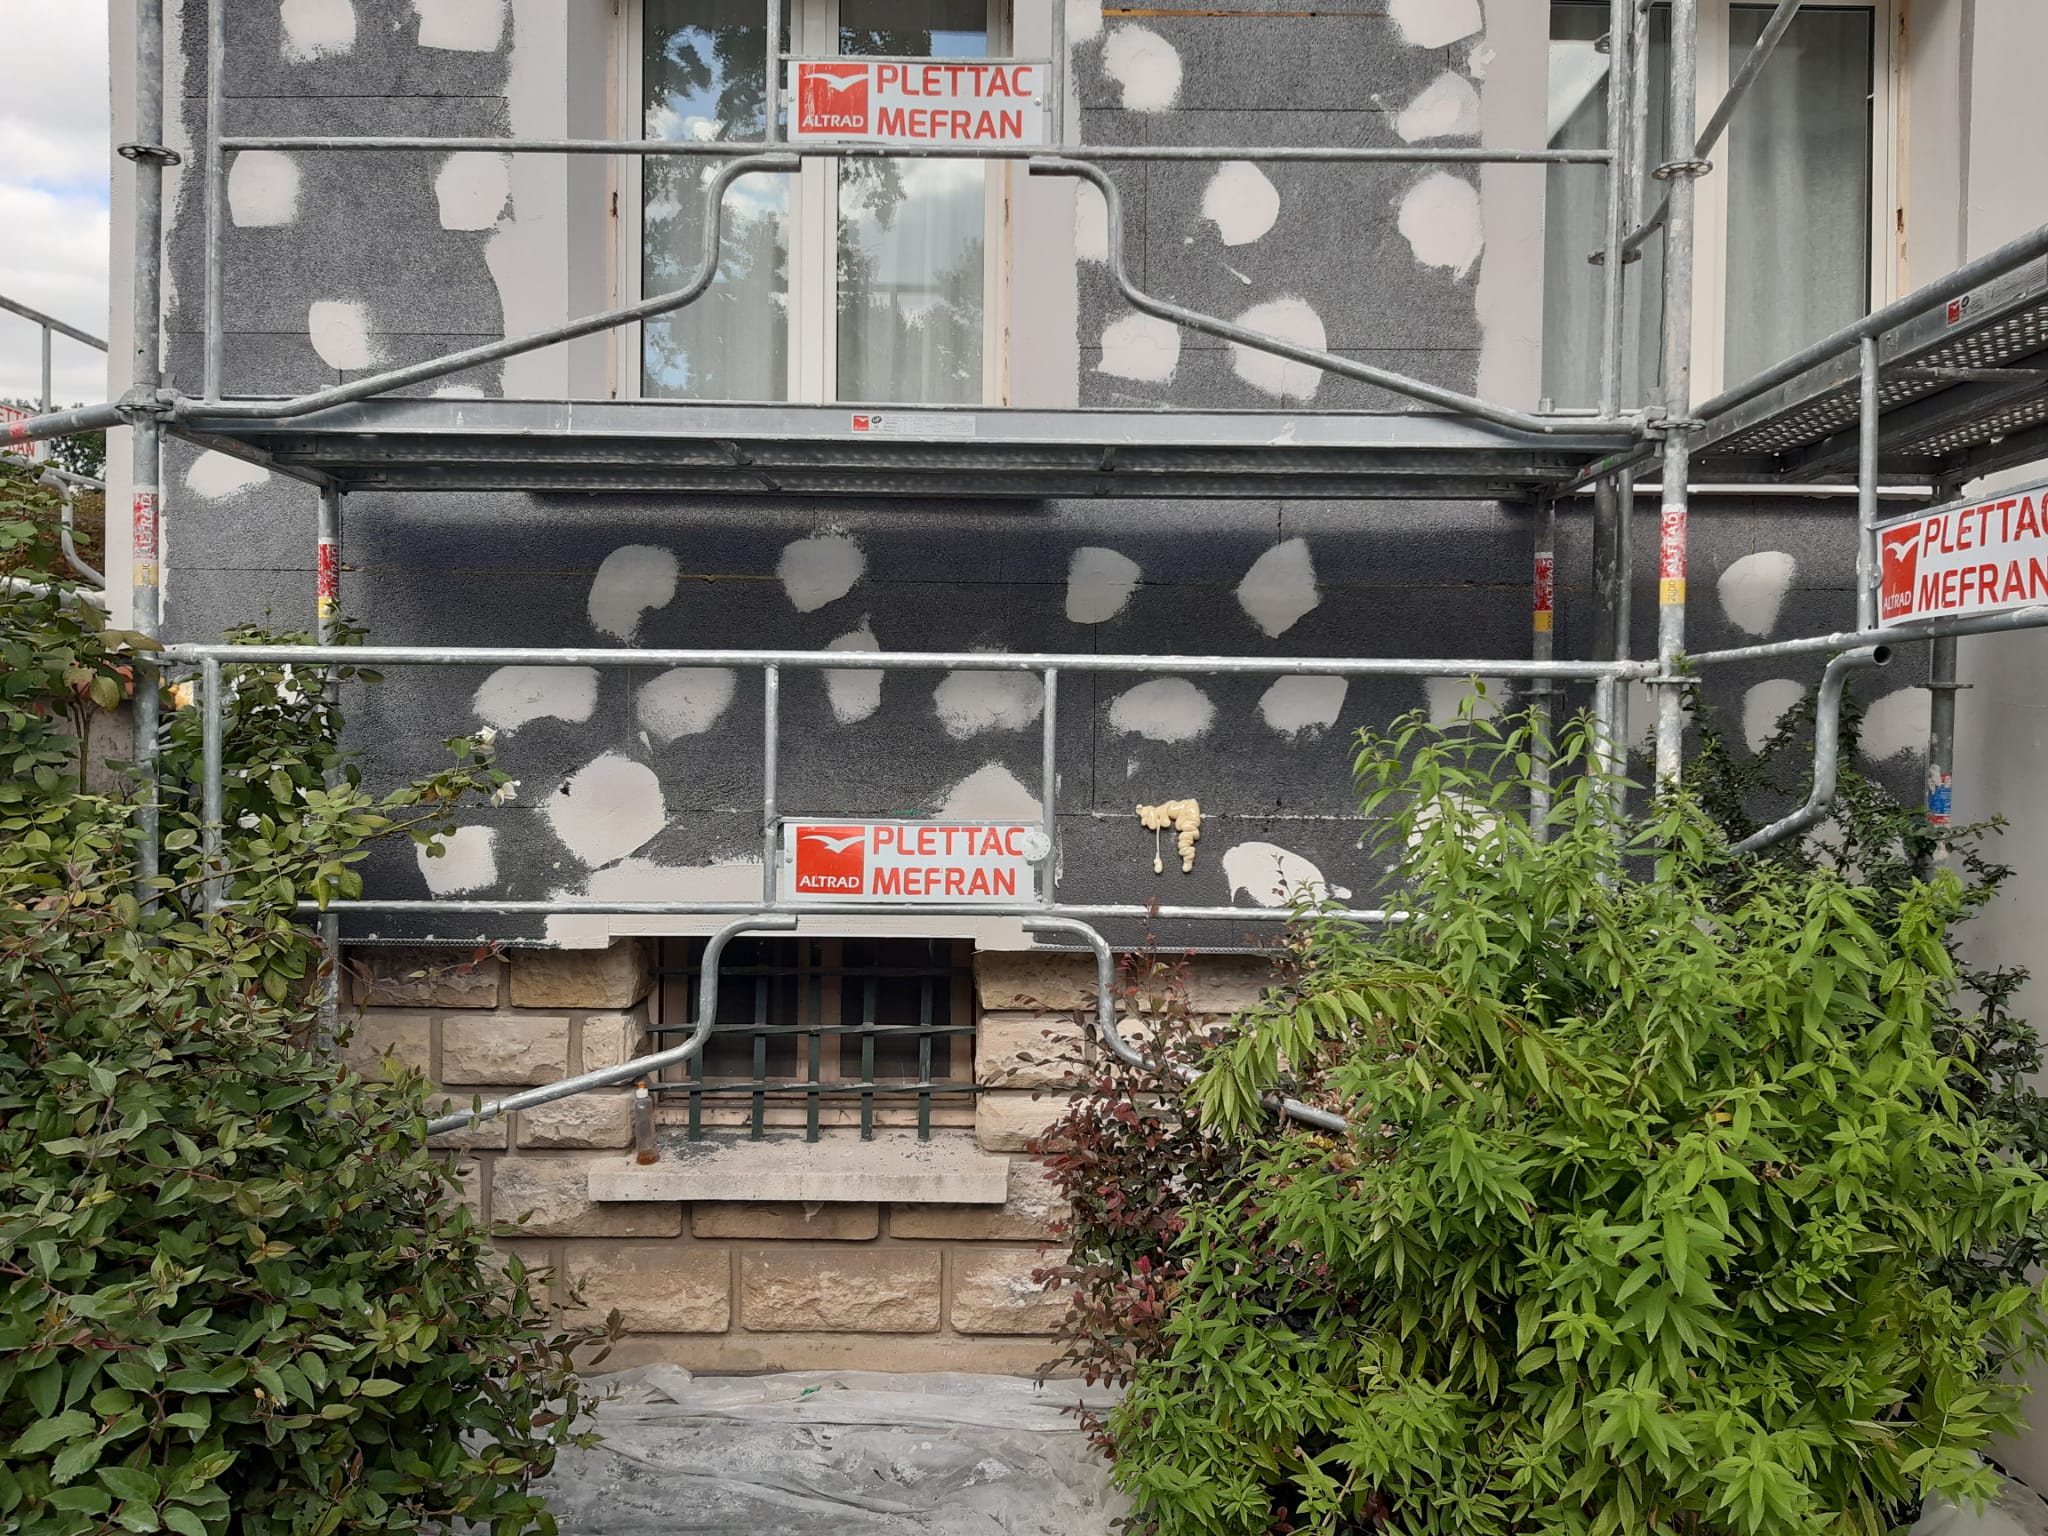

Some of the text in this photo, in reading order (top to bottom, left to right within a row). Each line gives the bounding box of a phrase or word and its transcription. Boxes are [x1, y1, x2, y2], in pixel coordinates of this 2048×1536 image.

[877, 64, 1033, 97] PLETTAC
[801, 114, 864, 128] ALTRAD
[877, 107, 1023, 140] MEFRAN
[1918, 555, 2048, 612] MEFRAN
[1883, 591, 1912, 612] ALTRAD
[872, 827, 1025, 856] PLETTAC
[800, 876, 860, 889] ALTRAD
[872, 867, 1016, 896] MEFRAN
